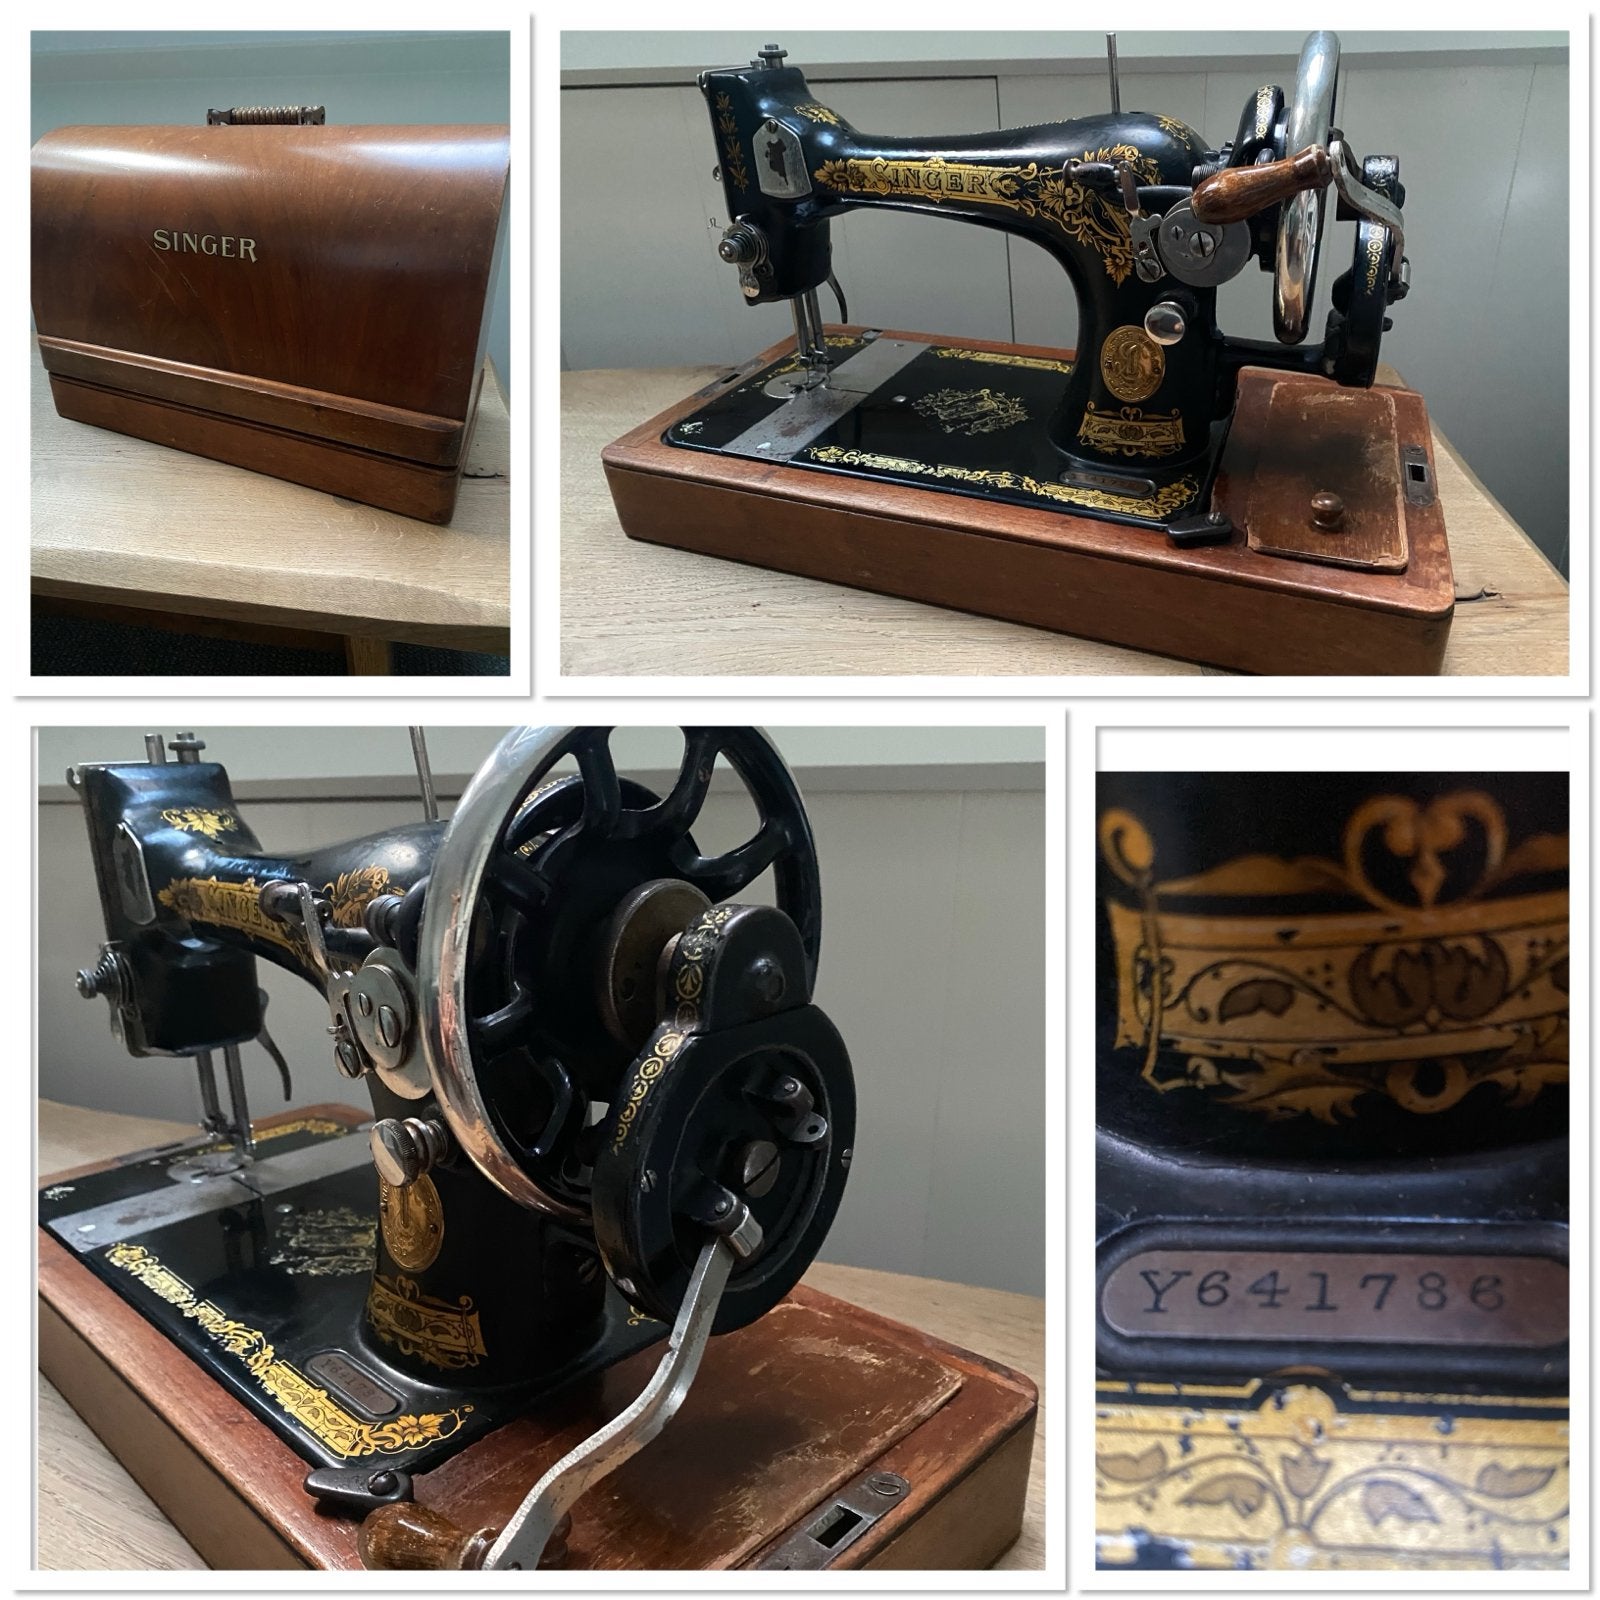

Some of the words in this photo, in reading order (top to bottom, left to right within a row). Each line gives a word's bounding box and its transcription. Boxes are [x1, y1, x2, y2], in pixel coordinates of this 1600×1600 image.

[870, 157, 988, 195] SINGER
[153, 229, 258, 263] SINGER
[206, 882, 276, 932] SINGE
[1139, 1269, 1505, 1314] Y641786
